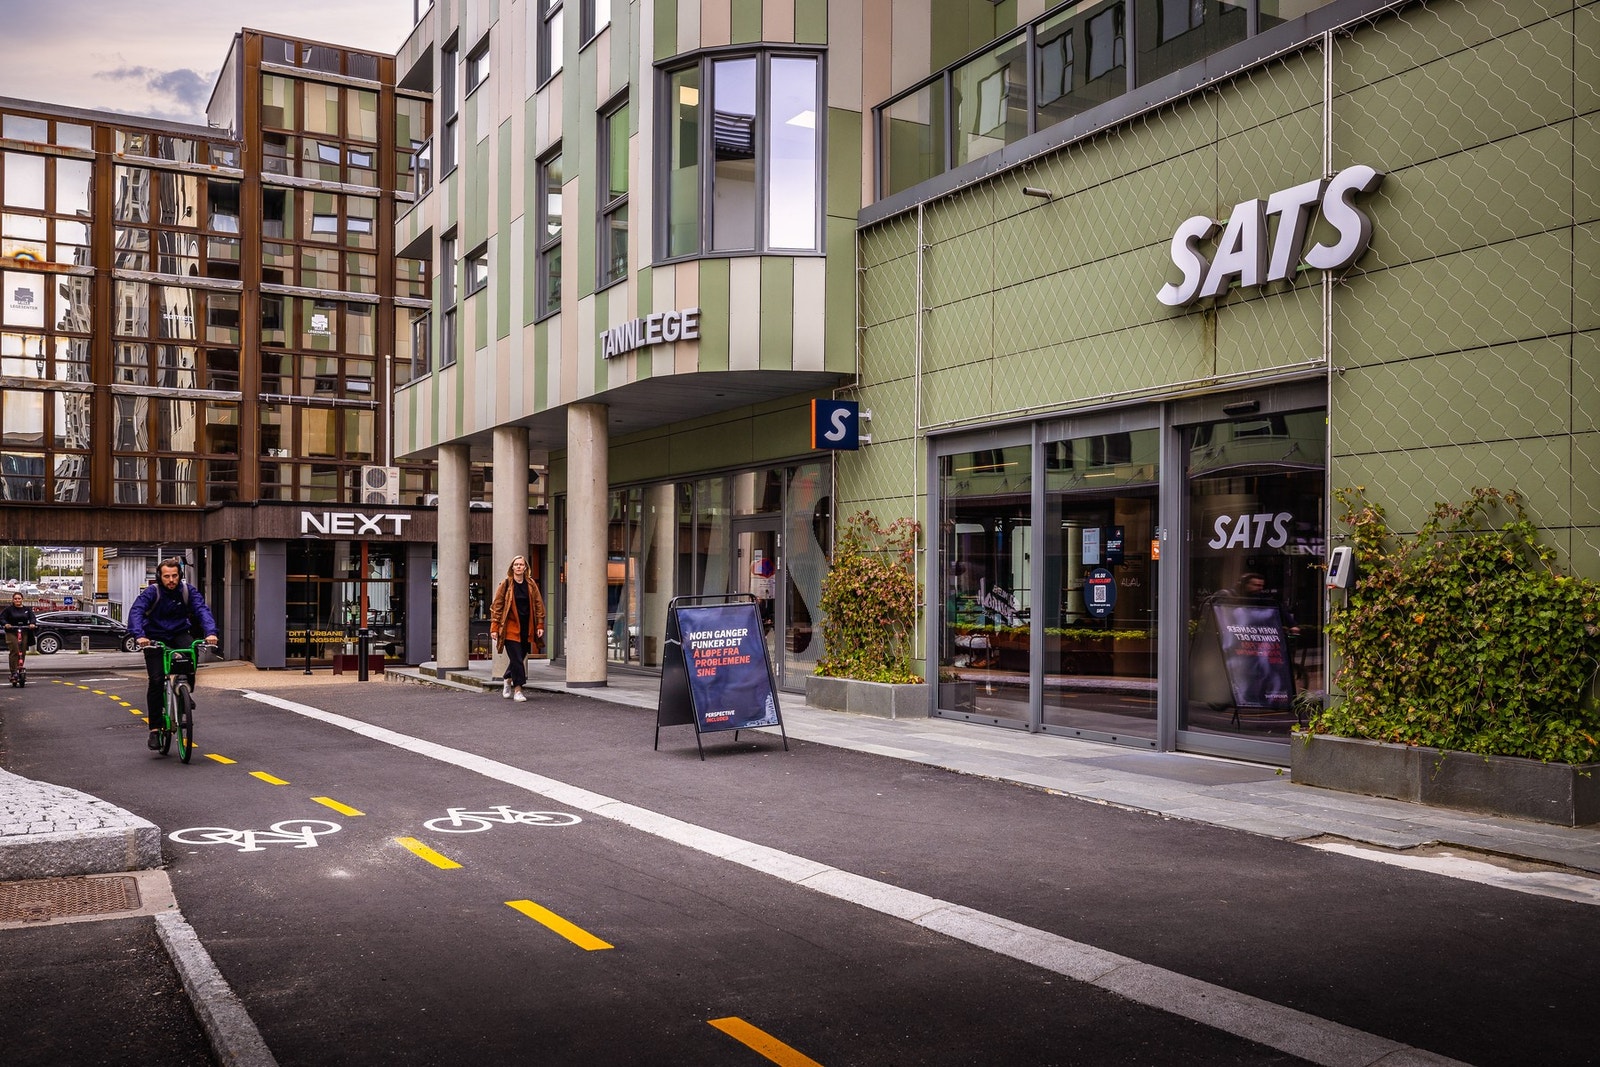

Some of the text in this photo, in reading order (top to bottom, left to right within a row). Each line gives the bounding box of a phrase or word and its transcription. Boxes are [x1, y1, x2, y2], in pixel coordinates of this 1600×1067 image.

[1156, 164, 1382, 306] SATS
[600, 307, 700, 359] TANNLEGE
[824, 408, 851, 441] S
[301, 511, 411, 535] NEXT
[1208, 512, 1293, 550] SATS
[690, 628, 748, 641] NOEN GANGER
[691, 638, 742, 649] FUNKER DET
[693, 647, 739, 658] Å LØPE FRA
[695, 655, 751, 668] PROBLEMENE
[696, 667, 716, 677] SINE
[705, 710, 735, 718] PERSPECTIVE
